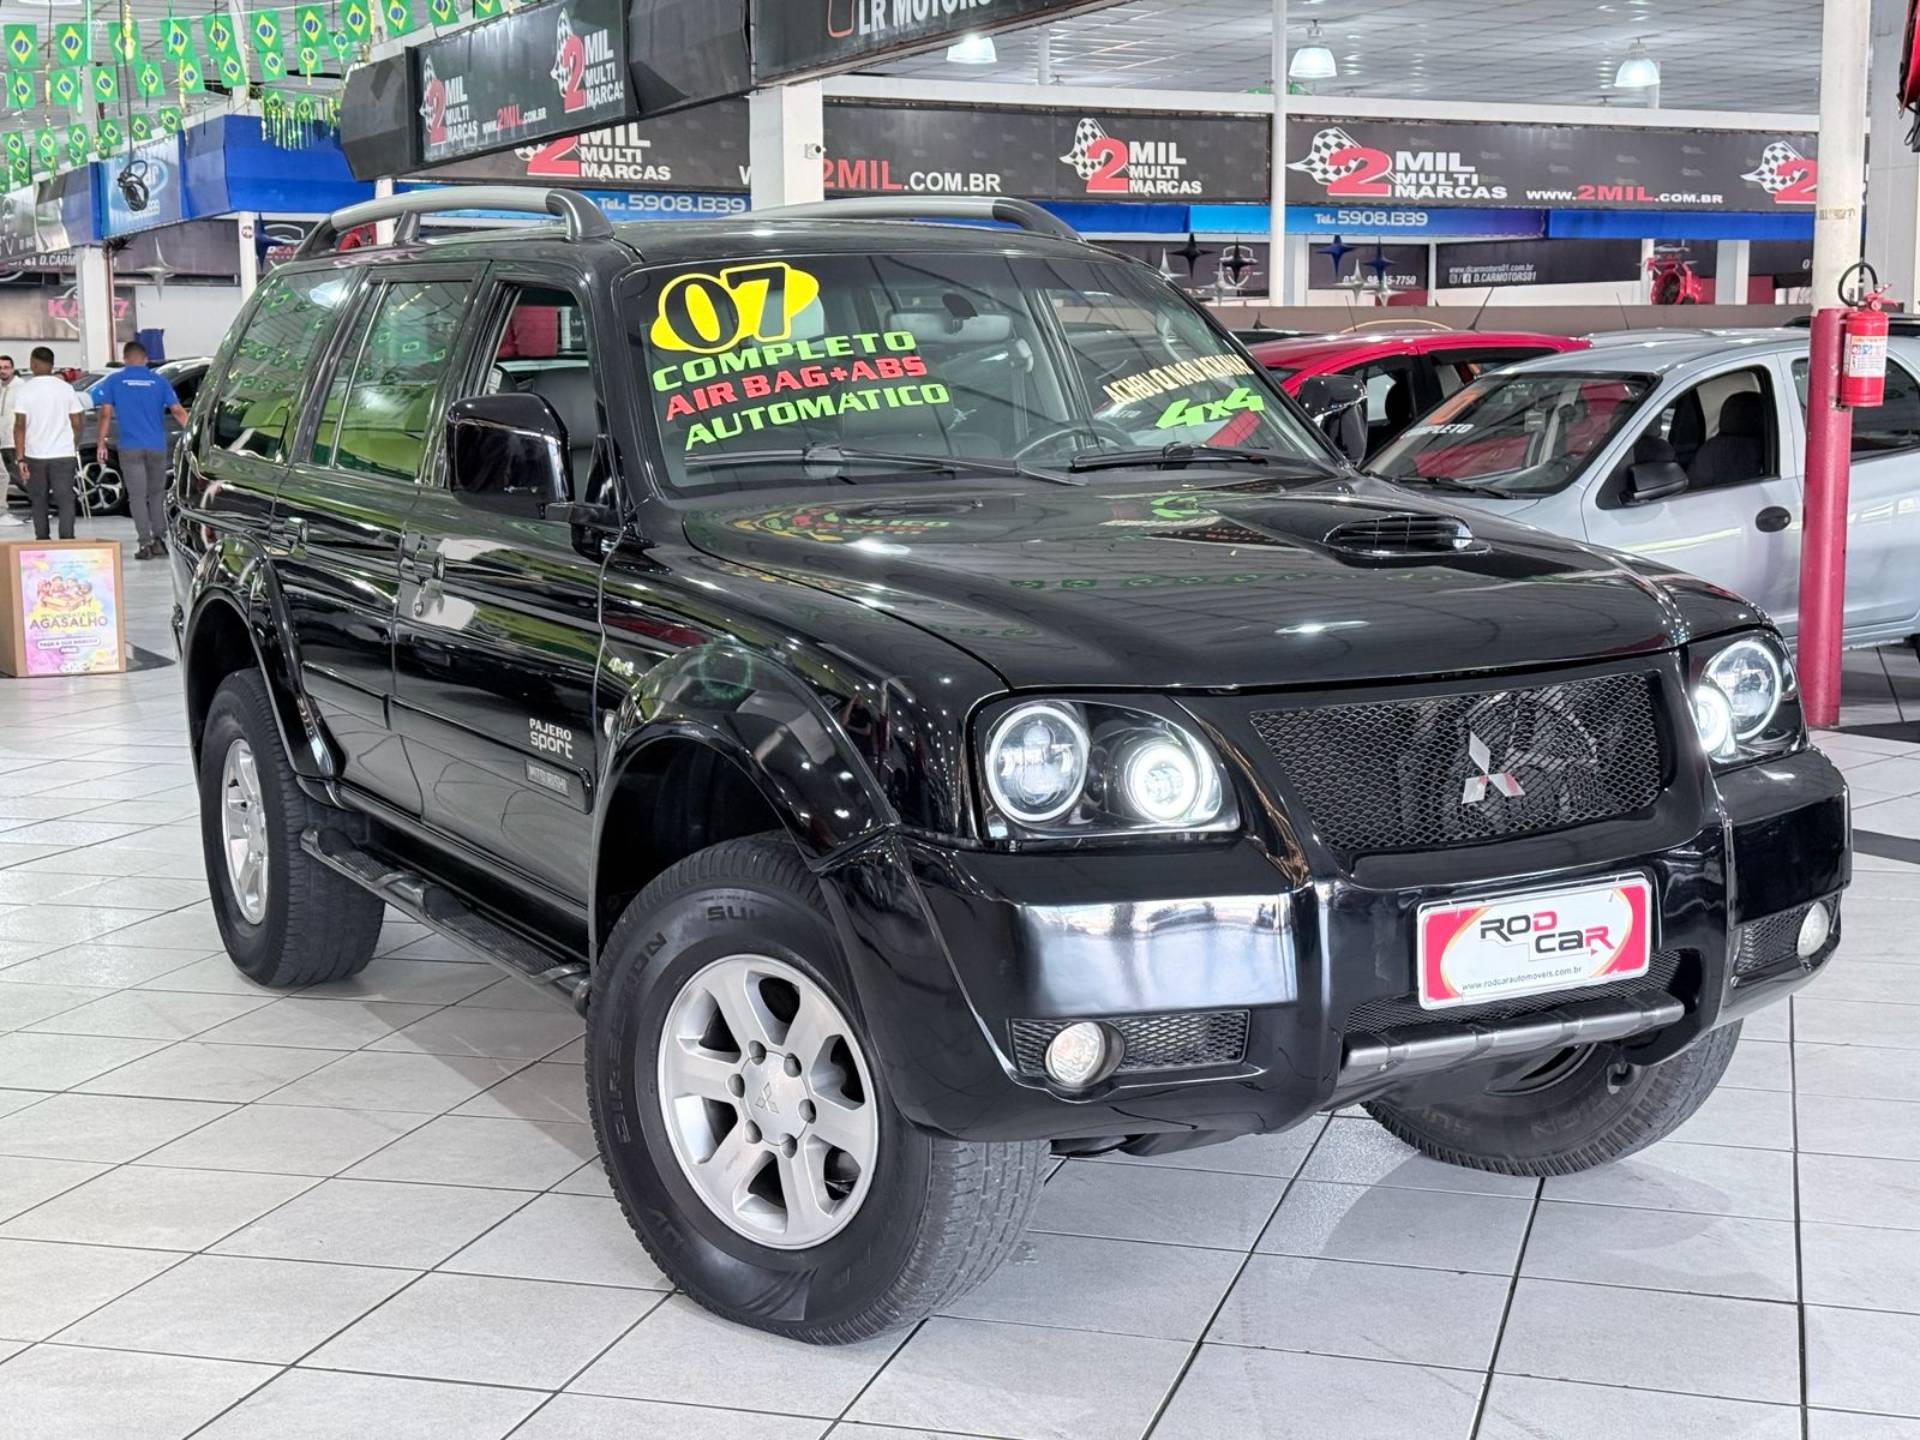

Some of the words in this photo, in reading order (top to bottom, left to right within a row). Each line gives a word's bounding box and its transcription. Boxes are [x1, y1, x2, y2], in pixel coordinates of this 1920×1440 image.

[892, 0, 992, 27] MOTOR
[584, 29, 614, 66] MIL
[585, 61, 616, 89] MULTI
[445, 76, 468, 106] MIL
[446, 104, 470, 127] MULTI
[446, 120, 478, 143] MARCAS
[580, 148, 643, 164] MULTI
[1086, 137, 1129, 193] 2
[1129, 141, 1187, 165] MIL
[580, 165, 671, 182] MARCAS
[1129, 165, 1179, 180] MULTI
[1326, 147, 1392, 196] 2
[1395, 150, 1476, 173] MIL
[1395, 172, 1479, 186] MULTI
[1129, 180, 1203, 195] MARCAS
[1395, 186, 1508, 200] MARCAS
[657, 262, 791, 352] 07
[652, 331, 917, 393] COMPLETO
[665, 381, 739, 422] AIR
[741, 356, 928, 399] BAG+ABS
[29, 615, 109, 631] AGASALHO
[528, 718, 573, 742] PAJERO
[1461, 965, 1583, 991] www.rodcarautomoveis.com.br
